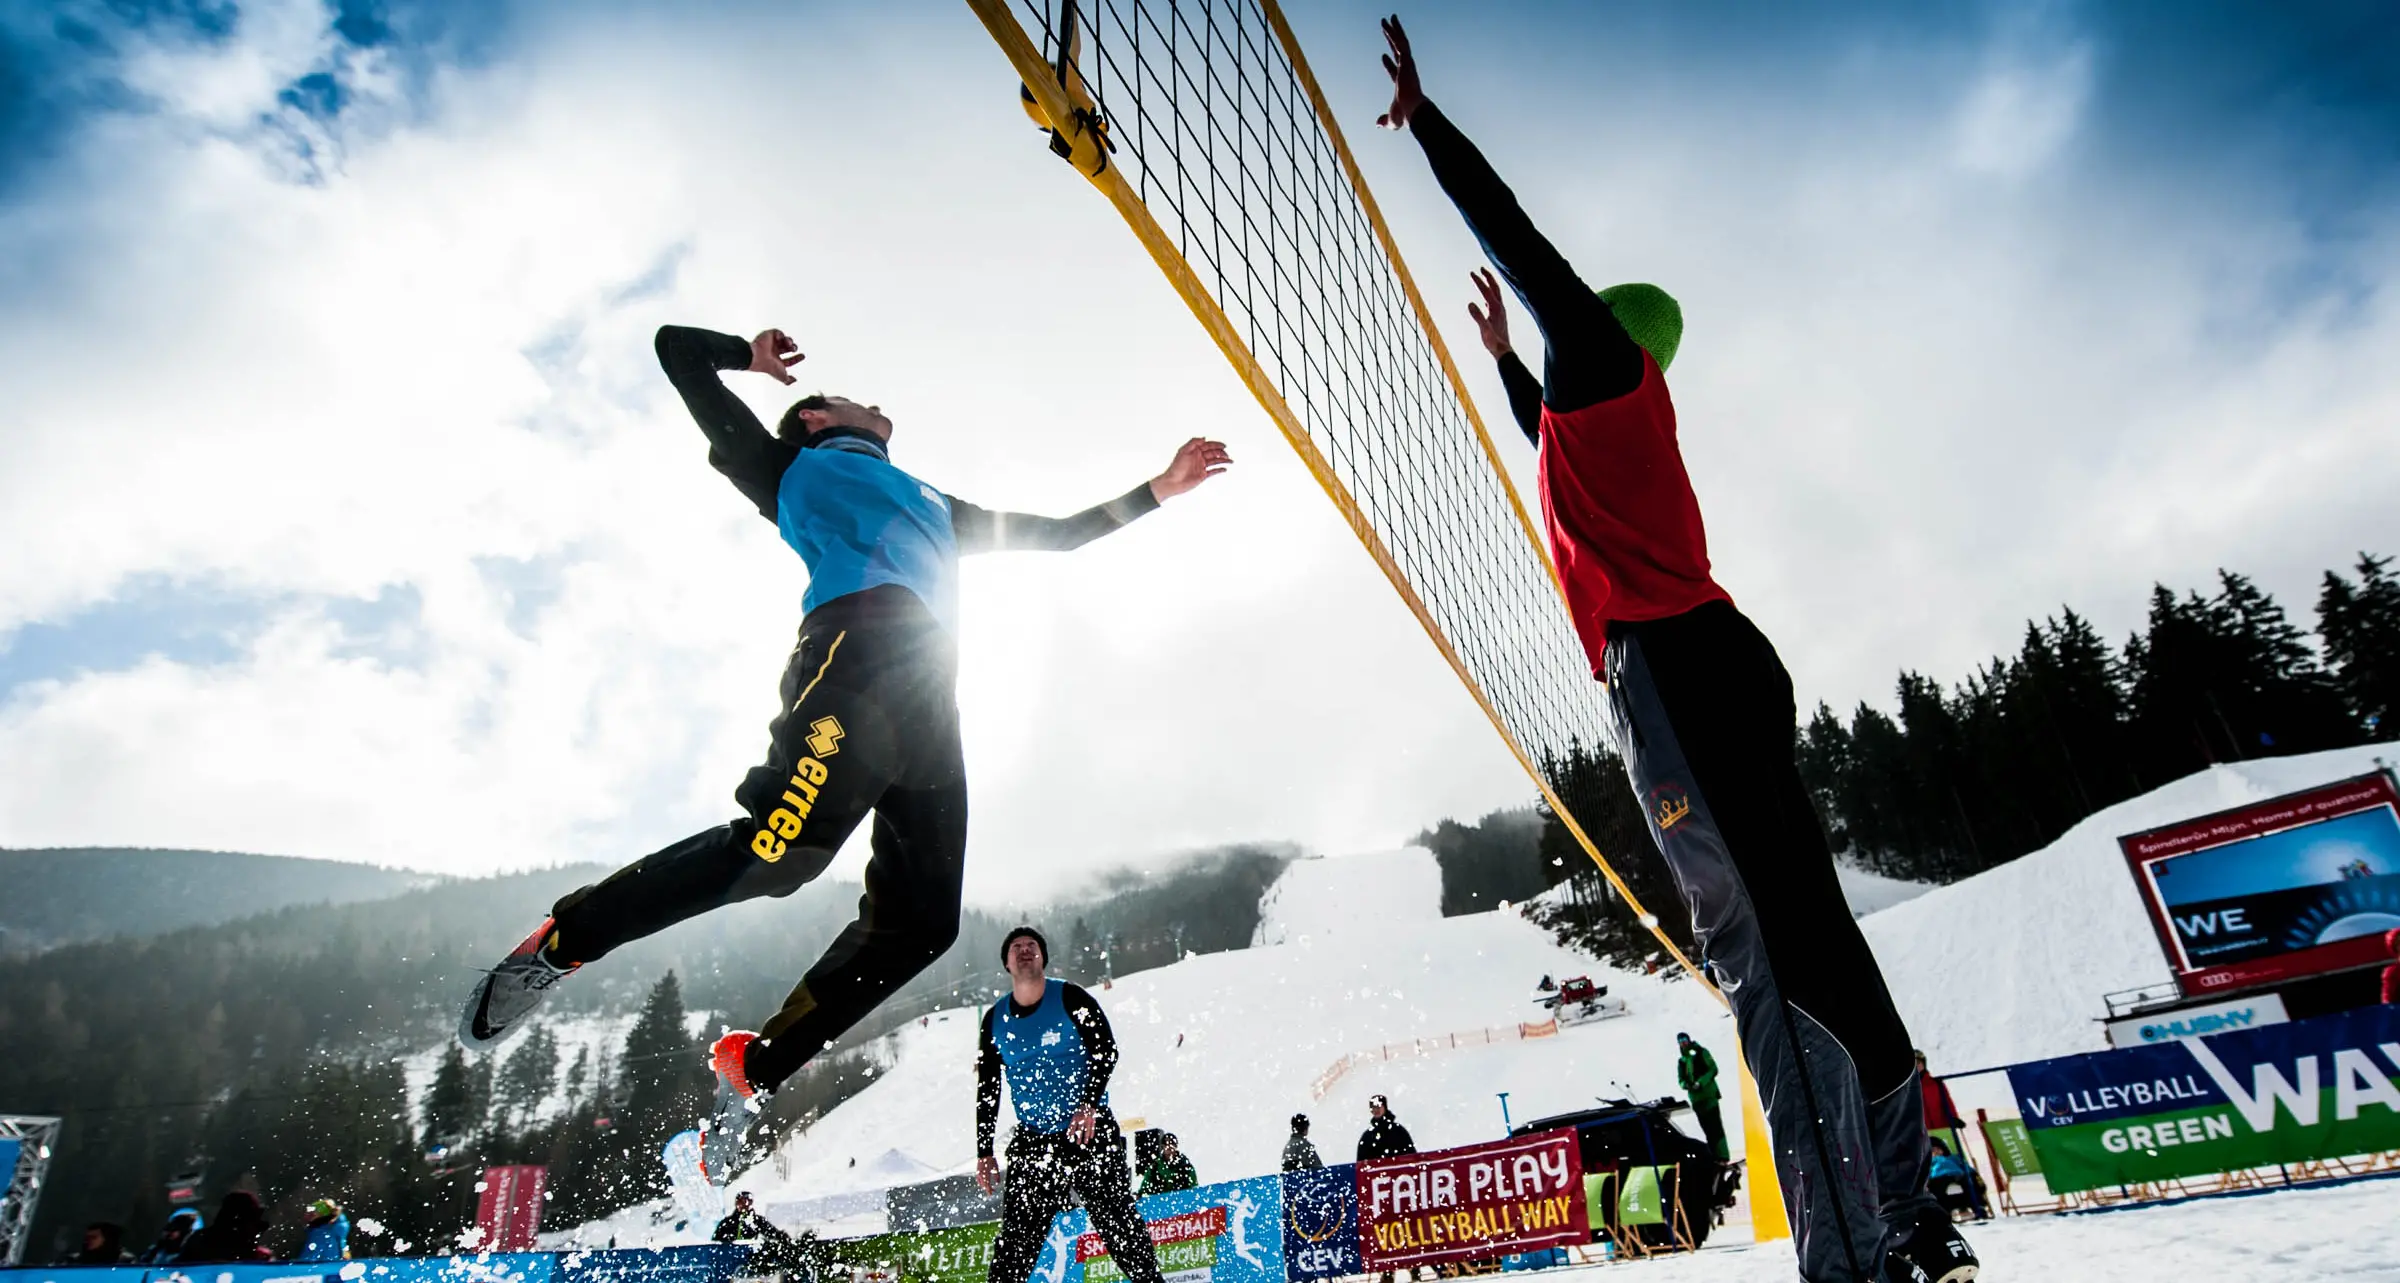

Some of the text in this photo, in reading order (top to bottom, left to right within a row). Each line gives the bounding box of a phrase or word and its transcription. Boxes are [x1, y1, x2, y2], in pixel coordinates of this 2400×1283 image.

[751, 756, 828, 863] errea
[2252, 809, 2295, 825] Home
[2297, 803, 2312, 815] of
[2175, 908, 2252, 937] WE
[2027, 1074, 2208, 1119] VOLLEYBALL
[2052, 1115, 2074, 1127] CEV
[2101, 1114, 2234, 1154] GREEN
[1371, 1168, 1458, 1218] FAIR
[1469, 1148, 1569, 1202] PLAY
[1374, 1195, 1571, 1251] VOLLEYBALL WAY
[1168, 1243, 1212, 1266] TOUR
[1297, 1246, 1344, 1272] CEV
